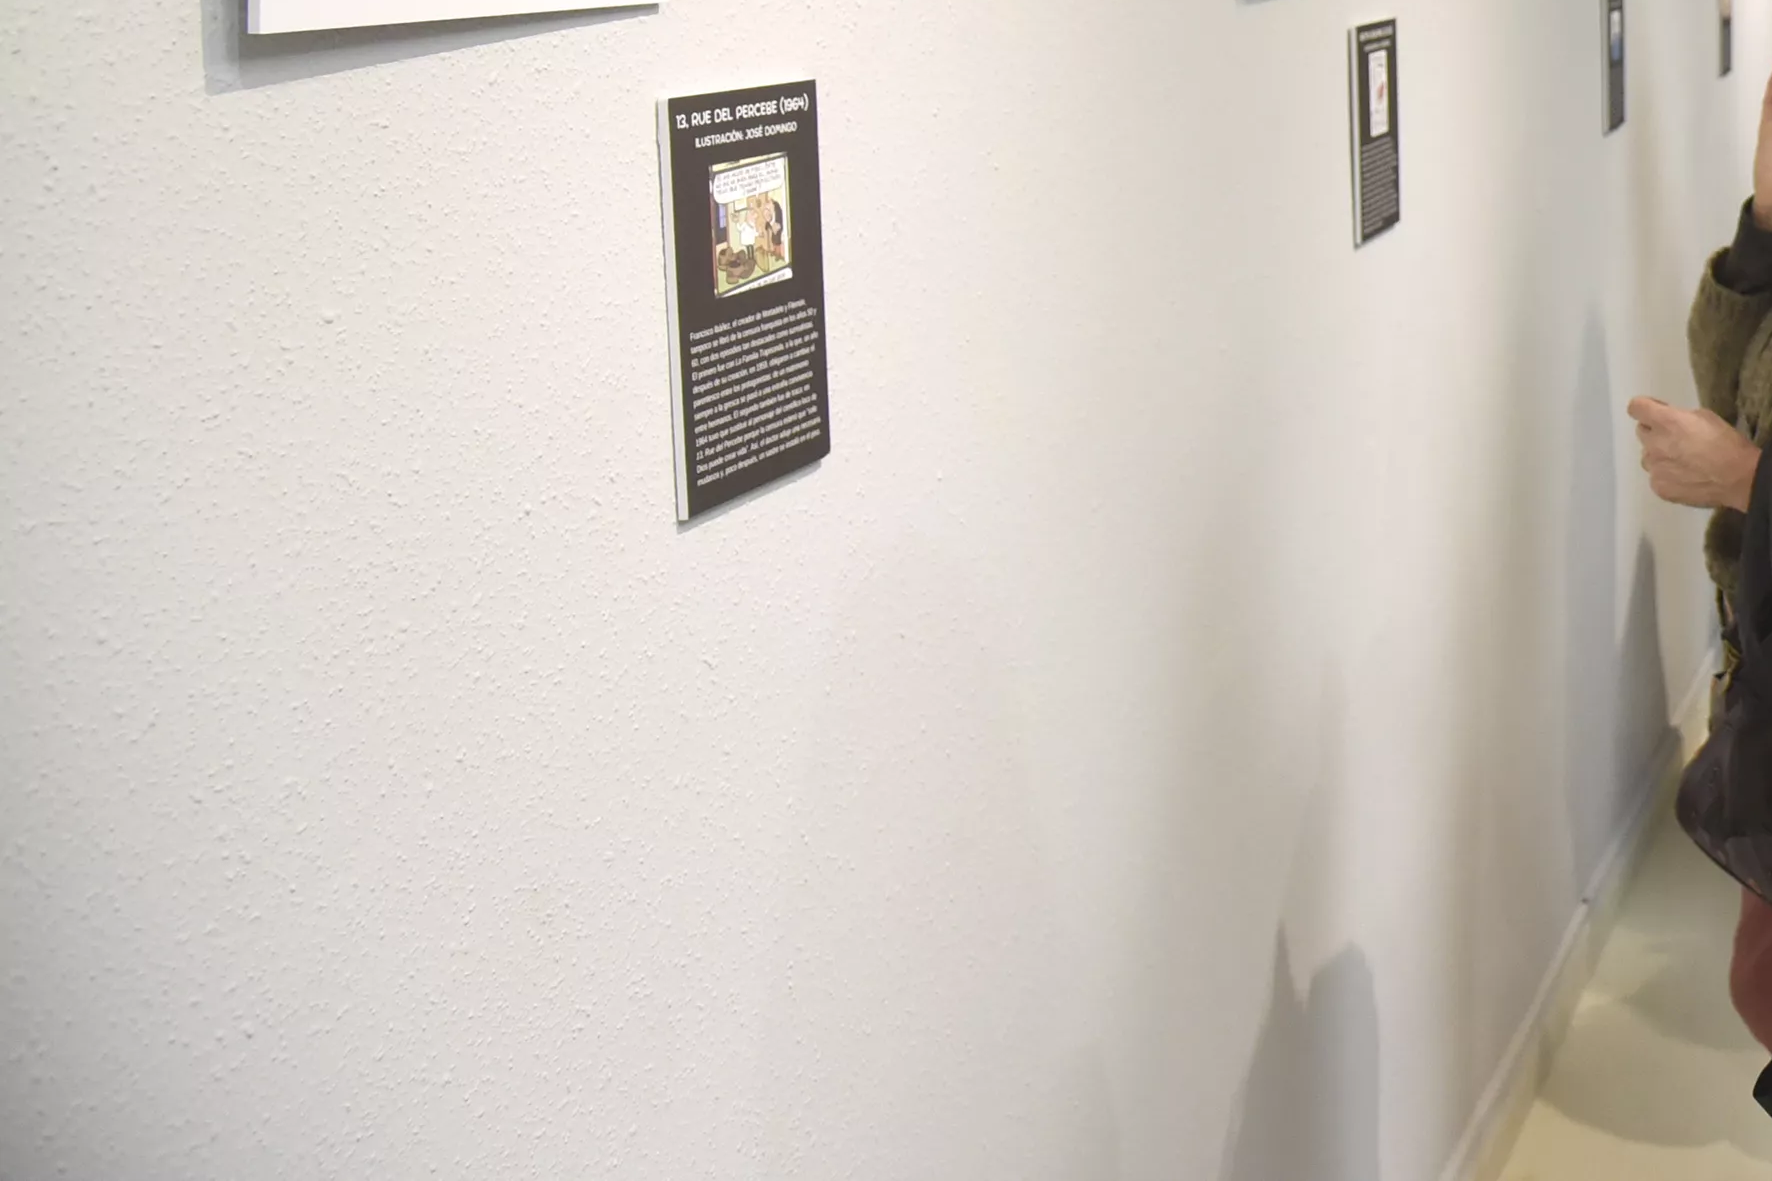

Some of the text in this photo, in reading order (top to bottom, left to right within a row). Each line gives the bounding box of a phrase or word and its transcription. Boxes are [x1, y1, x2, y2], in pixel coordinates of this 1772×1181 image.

[675, 93, 809, 129] 13, RUE DEL PERCEBE (1964)
[695, 121, 797, 148] ILUSTRACIÓN: JOSÉ DOMINGO
